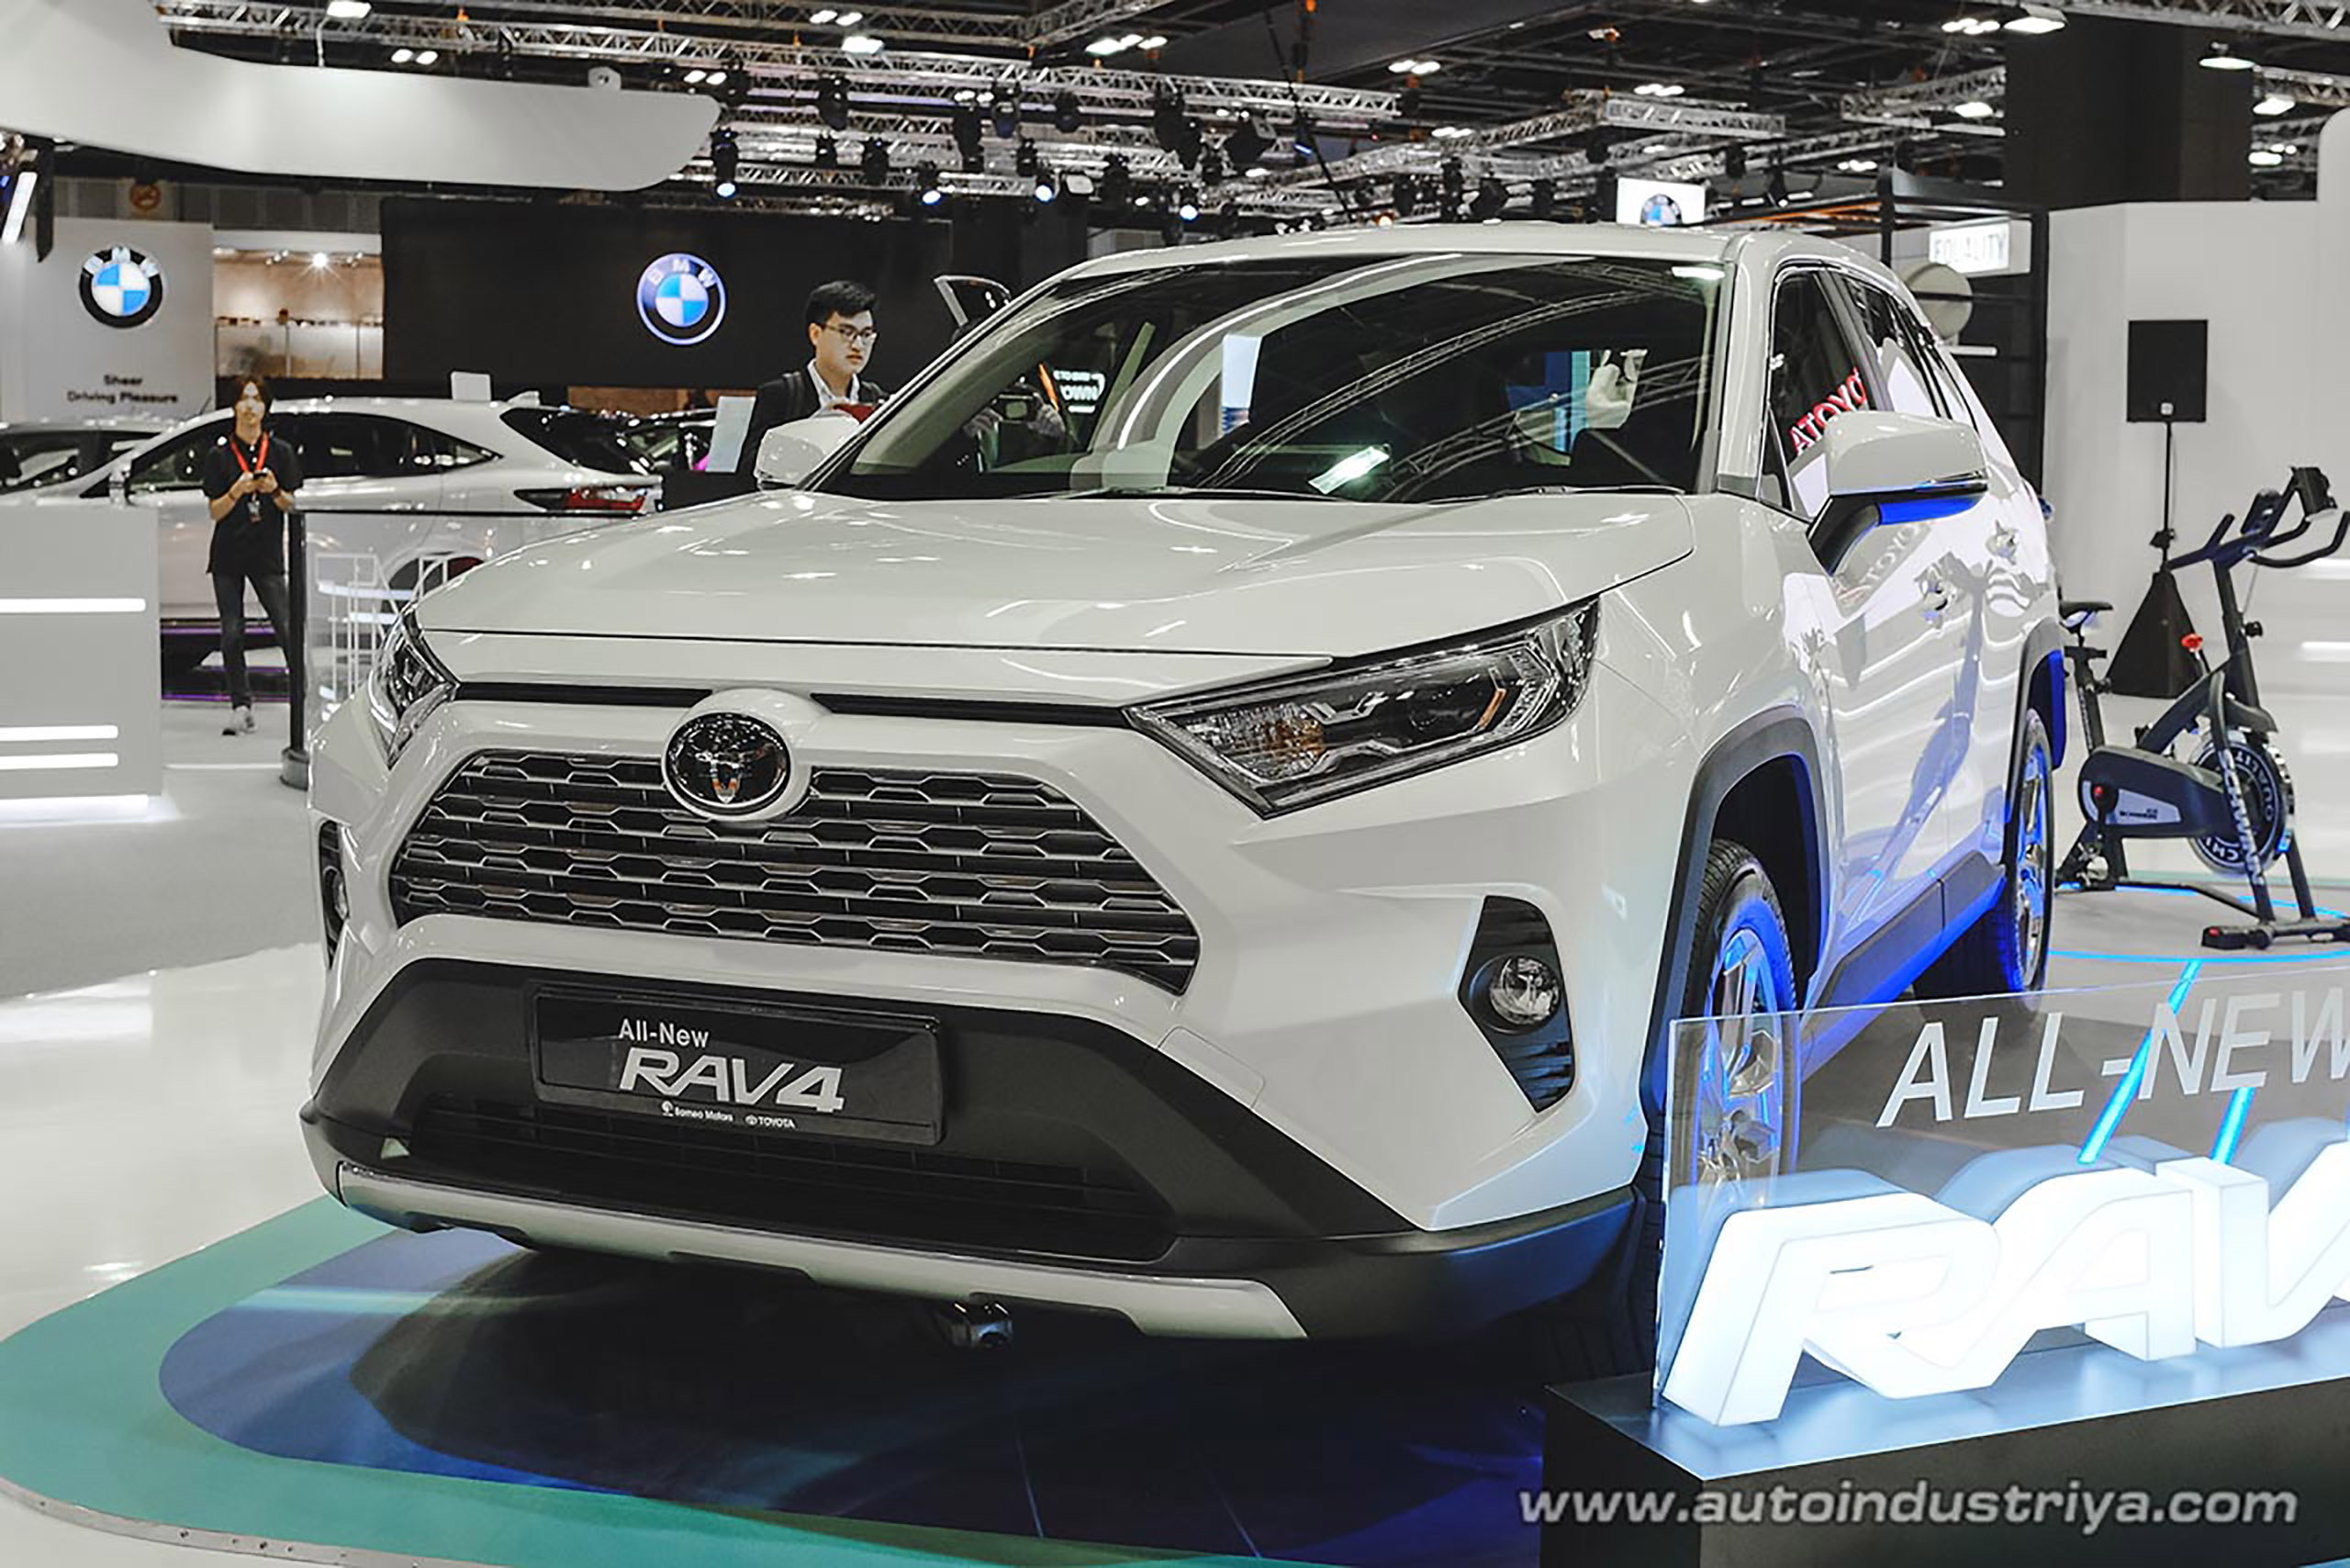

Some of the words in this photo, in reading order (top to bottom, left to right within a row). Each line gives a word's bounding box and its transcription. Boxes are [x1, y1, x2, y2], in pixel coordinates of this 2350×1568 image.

[67, 390, 117, 405] Driving
[119, 391, 179, 404] Pleasure
[2234, 750, 2275, 823] QUALIT
[618, 1018, 710, 1048] All-New
[619, 1046, 845, 1114] RAV4
[757, 1115, 797, 1130] TOYOTA
[1660, 1140, 2350, 1428] RAV
